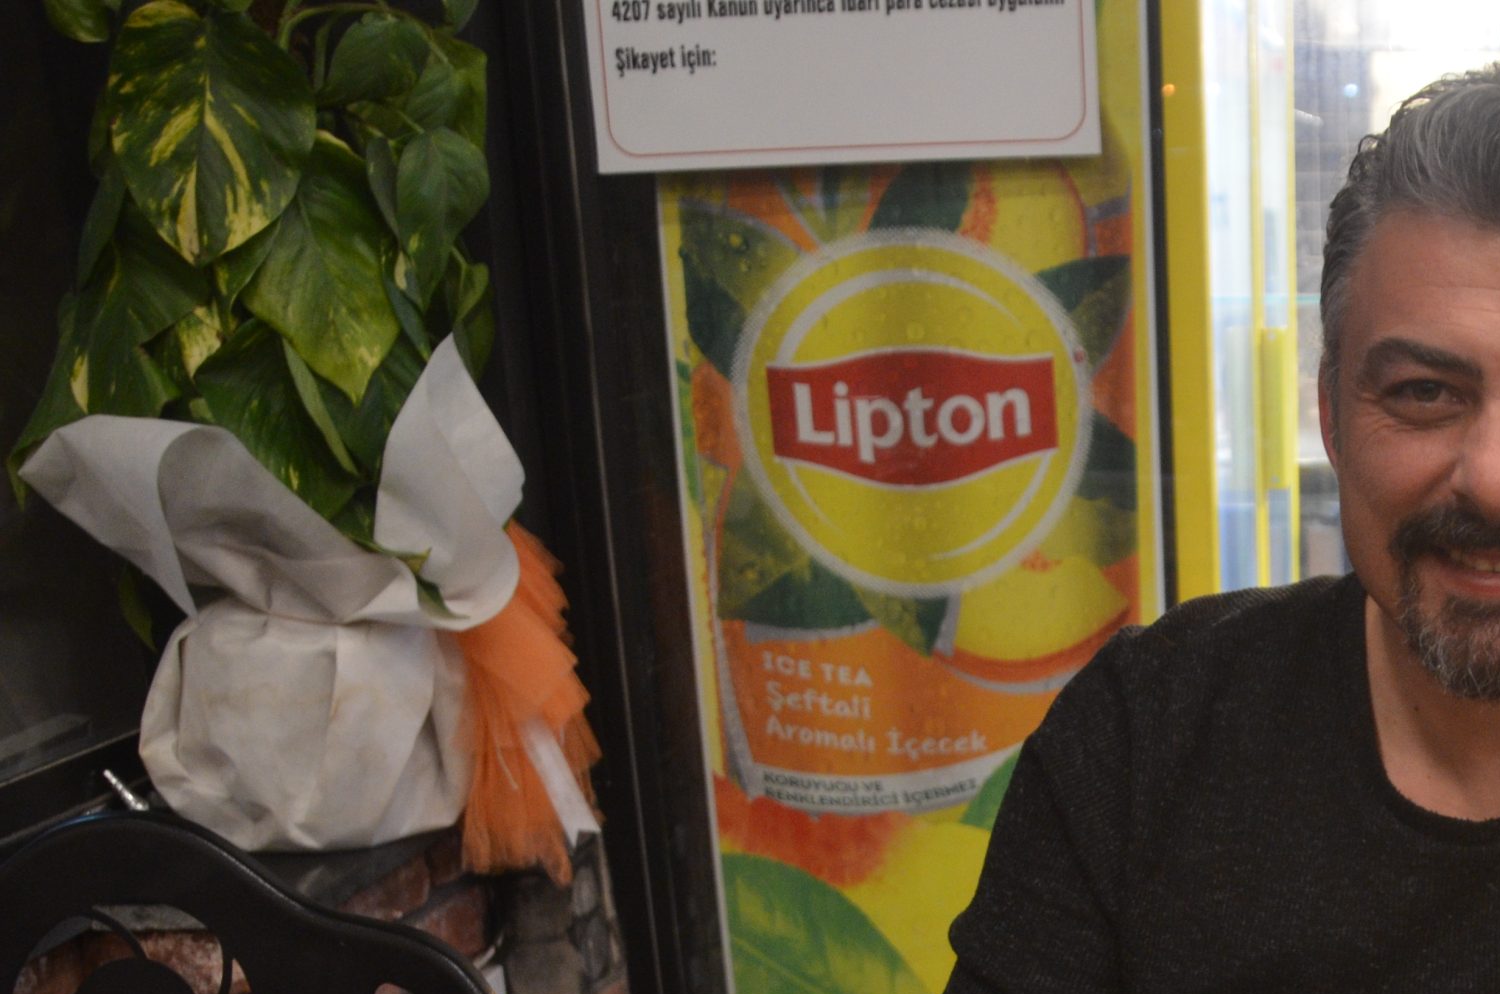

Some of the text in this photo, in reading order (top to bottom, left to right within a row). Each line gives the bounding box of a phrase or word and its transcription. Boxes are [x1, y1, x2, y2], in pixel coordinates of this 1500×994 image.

[612, 0, 650, 21] 4207
[615, 44, 717, 77] Şikayet için:
[791, 381, 1032, 463] Lipton
[762, 651, 873, 688] ICE TEA
[765, 680, 872, 720] Şeftali
[765, 714, 987, 762] Aromalı İçecek
[863, 780, 883, 792] VE
